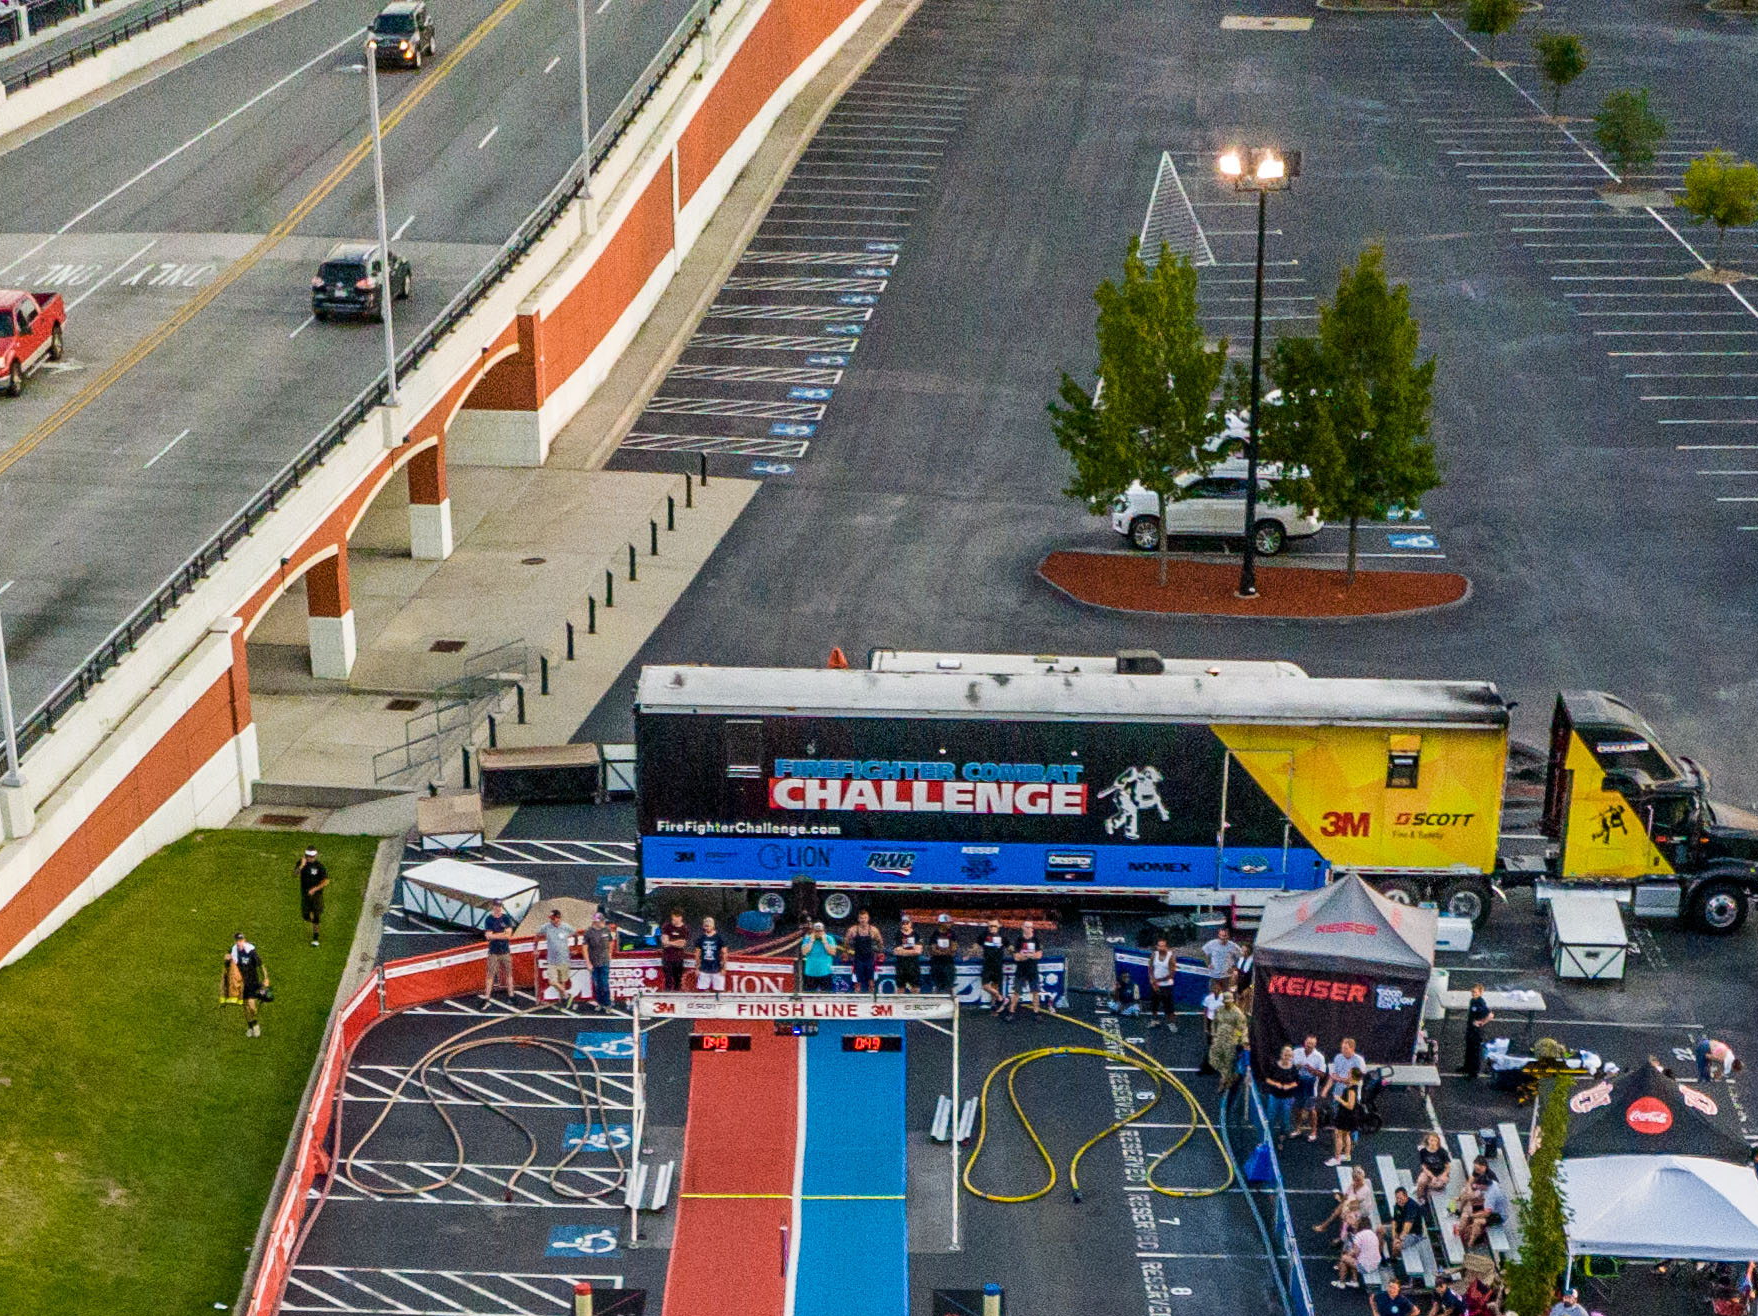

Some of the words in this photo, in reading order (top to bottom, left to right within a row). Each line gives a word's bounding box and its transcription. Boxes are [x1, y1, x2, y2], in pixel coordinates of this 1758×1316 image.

[775, 758, 956, 780] FIREFIGHTER
[962, 762, 1084, 784] COMBAT
[772, 779, 1083, 815] CHALLENGE
[656, 819, 842, 837] FireFighterChallenge.com
[1320, 811, 1371, 839] 3M
[1409, 813, 1475, 828] SCOTT
[786, 845, 831, 868] LION
[867, 851, 916, 870] RWC
[1128, 861, 1192, 874] NOMEX
[1268, 974, 1369, 1004] KEISER
[652, 1002, 676, 1014] 3M
[737, 1003, 805, 1017] FINISH
[813, 1004, 859, 1017] LINE
[871, 1004, 893, 1017] 3M
